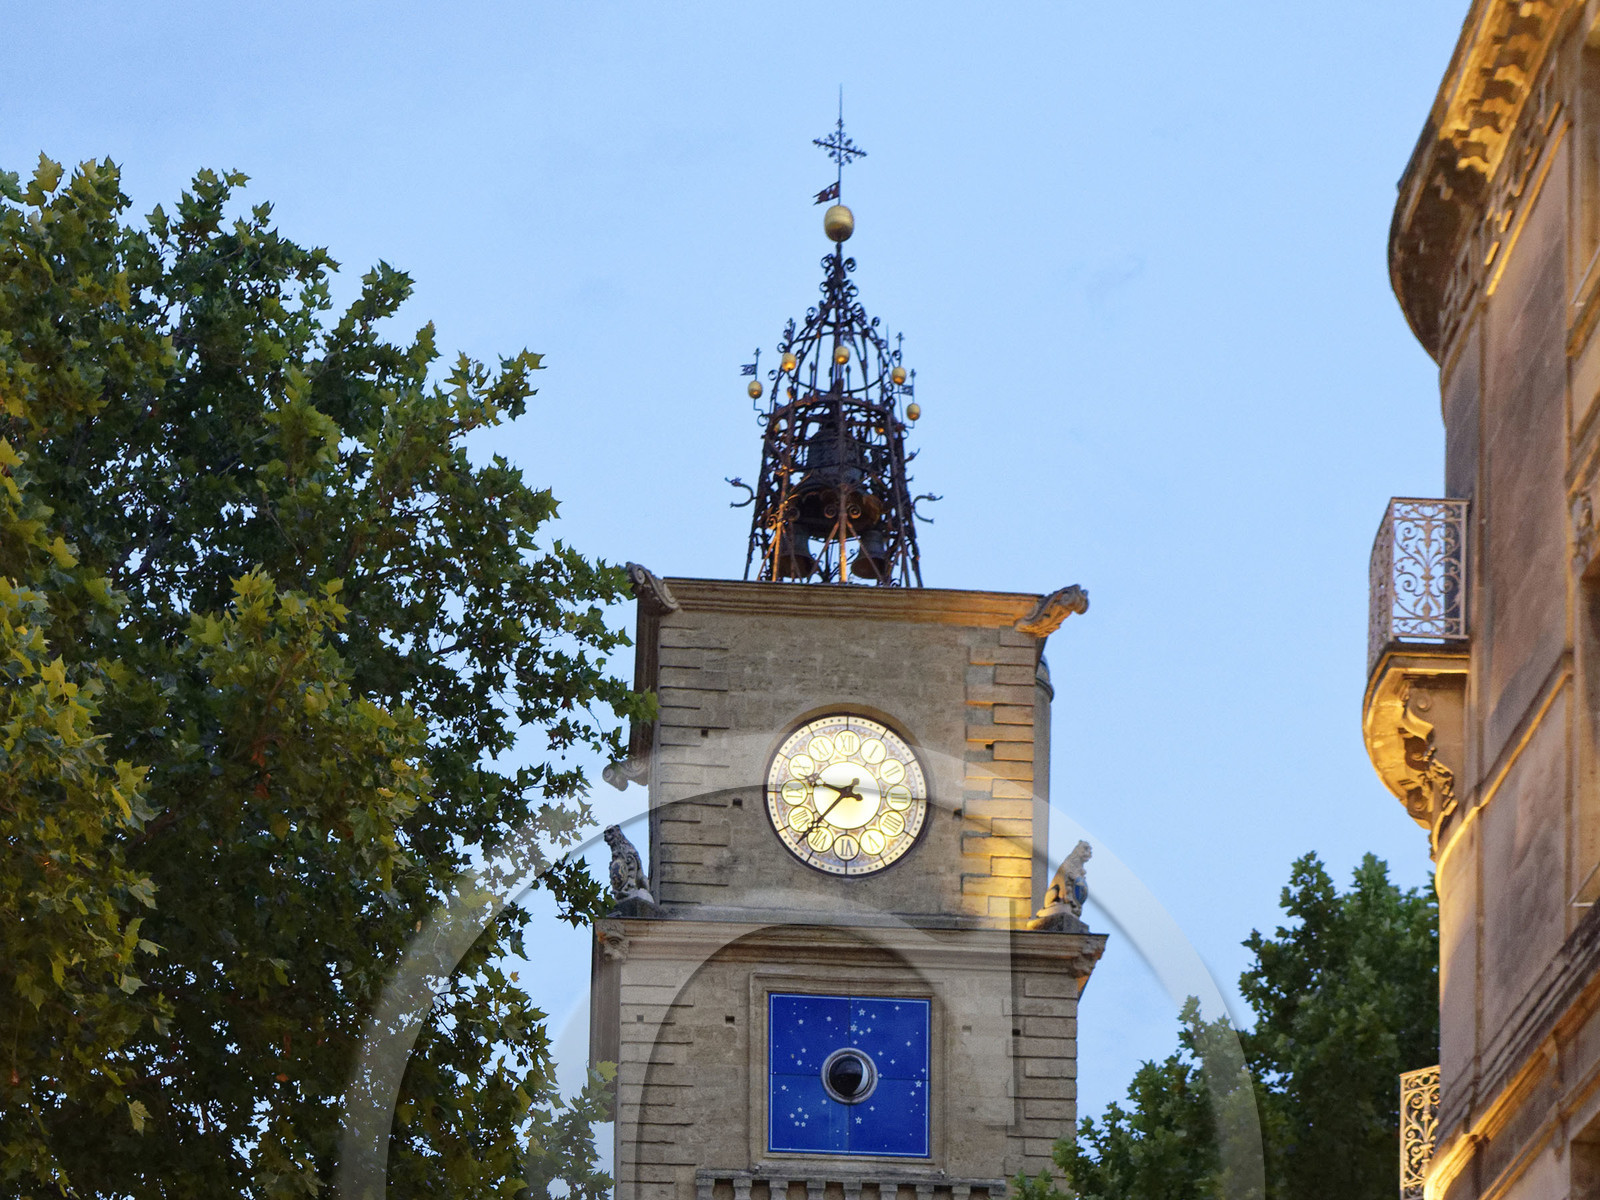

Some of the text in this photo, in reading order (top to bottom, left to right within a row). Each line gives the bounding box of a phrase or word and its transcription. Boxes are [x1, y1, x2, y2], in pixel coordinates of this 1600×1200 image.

[812, 740, 829, 759] XI
[841, 735, 854, 751] XII
[868, 744, 878, 759] I
[793, 760, 811, 774] X
[884, 765, 900, 778] II
[786, 786, 803, 799] IX
[891, 793, 907, 803] III
[812, 829, 827, 850] VII
[868, 835, 880, 852] V
[840, 839, 854, 856] VI
